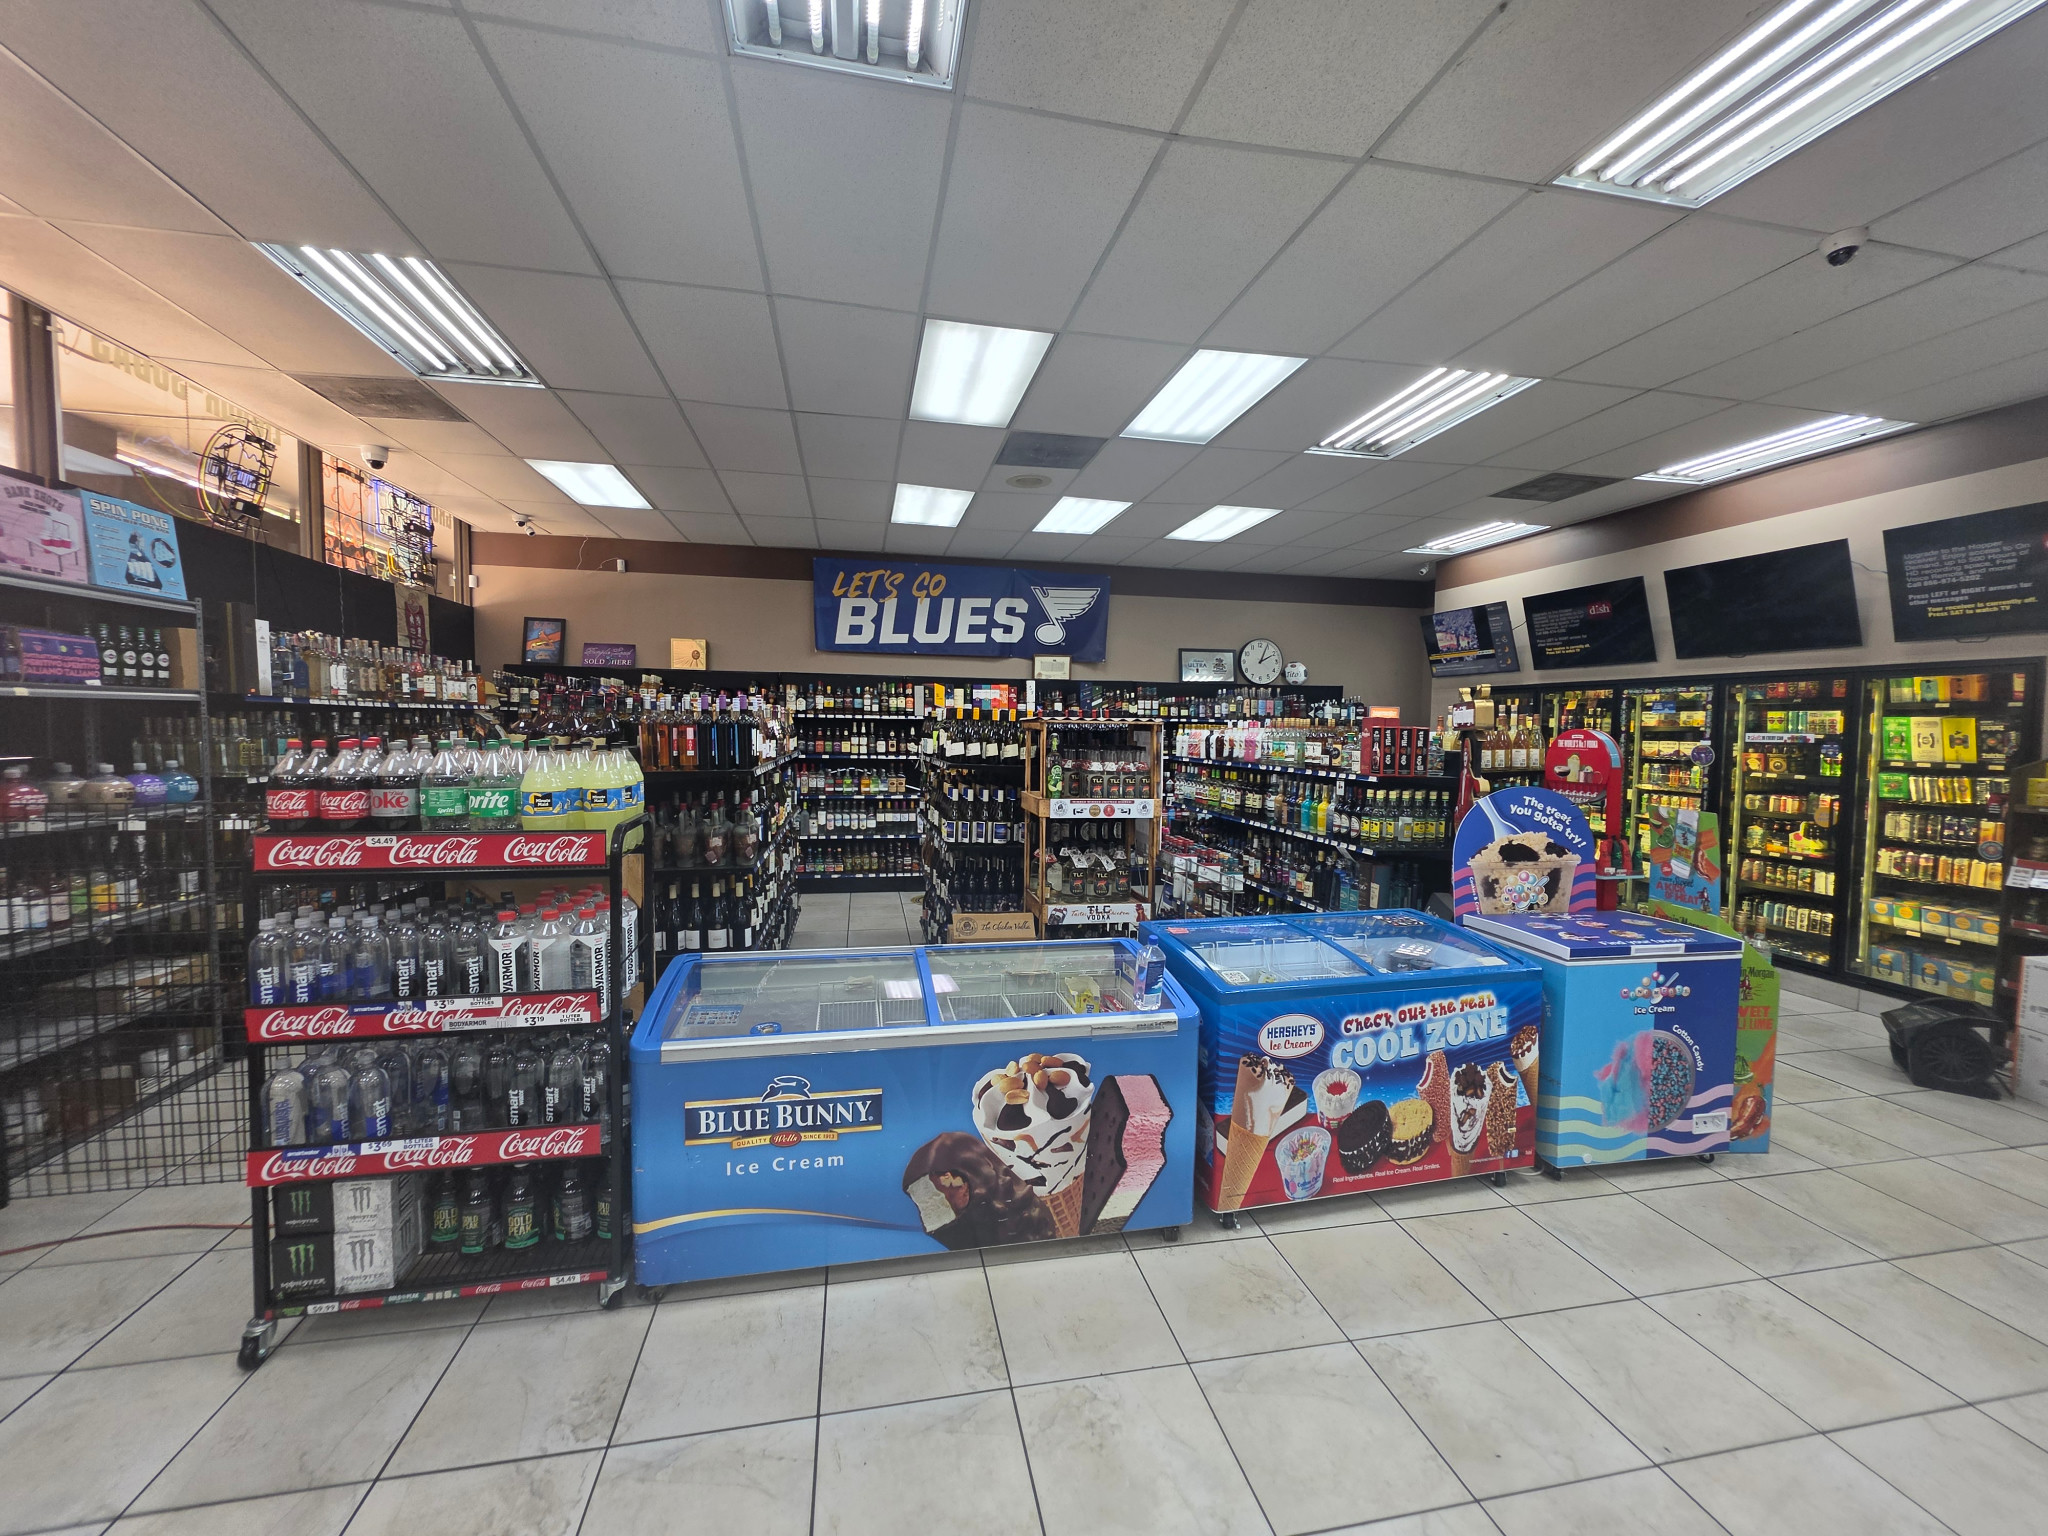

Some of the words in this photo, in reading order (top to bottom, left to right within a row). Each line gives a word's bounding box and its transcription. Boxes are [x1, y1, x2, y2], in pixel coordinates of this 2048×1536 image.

[90, 499, 127, 517] SPIN
[132, 510, 169, 530] PONG
[832, 569, 904, 603] LET'S
[912, 571, 946, 604] GO
[835, 598, 1029, 644] BLUES
[1589, 603, 1611, 614] dish
[1523, 796, 1544, 810] The
[1546, 806, 1572, 825] treat
[1510, 804, 1532, 816] you
[1533, 811, 1563, 832] gotta
[1565, 828, 1587, 848] try!
[268, 838, 367, 867] Coca-Cola
[389, 837, 482, 865] Coca-Cola
[503, 836, 593, 864] Coca-Cola
[1087, 905, 1110, 914] TLC
[257, 967, 274, 1005] smart
[295, 965, 309, 1003] smart
[397, 958, 410, 997] smart
[425, 960, 438, 997] smart
[466, 955, 480, 994] smart
[501, 951, 513, 993] YARMOR
[260, 1008, 356, 1038] Coca-Cola
[1430, 1000, 1457, 1018] the
[1267, 1024, 1316, 1039] HERSHEY'S
[1269, 1040, 1281, 1050] Ice
[1284, 1040, 1313, 1049] Cream
[1331, 1028, 1420, 1070] COOL
[1426, 1008, 1508, 1052] ZONE
[1672, 1024, 1694, 1046] Cotton
[1692, 1045, 1704, 1072] Candy
[508, 1089, 519, 1125] smart
[545, 1087, 554, 1122] smart
[583, 1077, 591, 1112] smart
[373, 1098, 386, 1137] smart
[698, 1107, 770, 1135] BLUE
[776, 1100, 873, 1130] BUNNY
[499, 1128, 588, 1160] Coca-Cola
[736, 1138, 767, 1147] QUALITY
[773, 1134, 798, 1143] Wells
[261, 1153, 356, 1181] Coca-Cola
[726, 1161, 759, 1176] Ice
[772, 1155, 844, 1172] Cream
[508, 1215, 532, 1227] GOLD
[509, 1224, 532, 1236] PEAK
[476, 1284, 501, 1294] Coca-Cola
[522, 1278, 546, 1288] Coca-Cola
